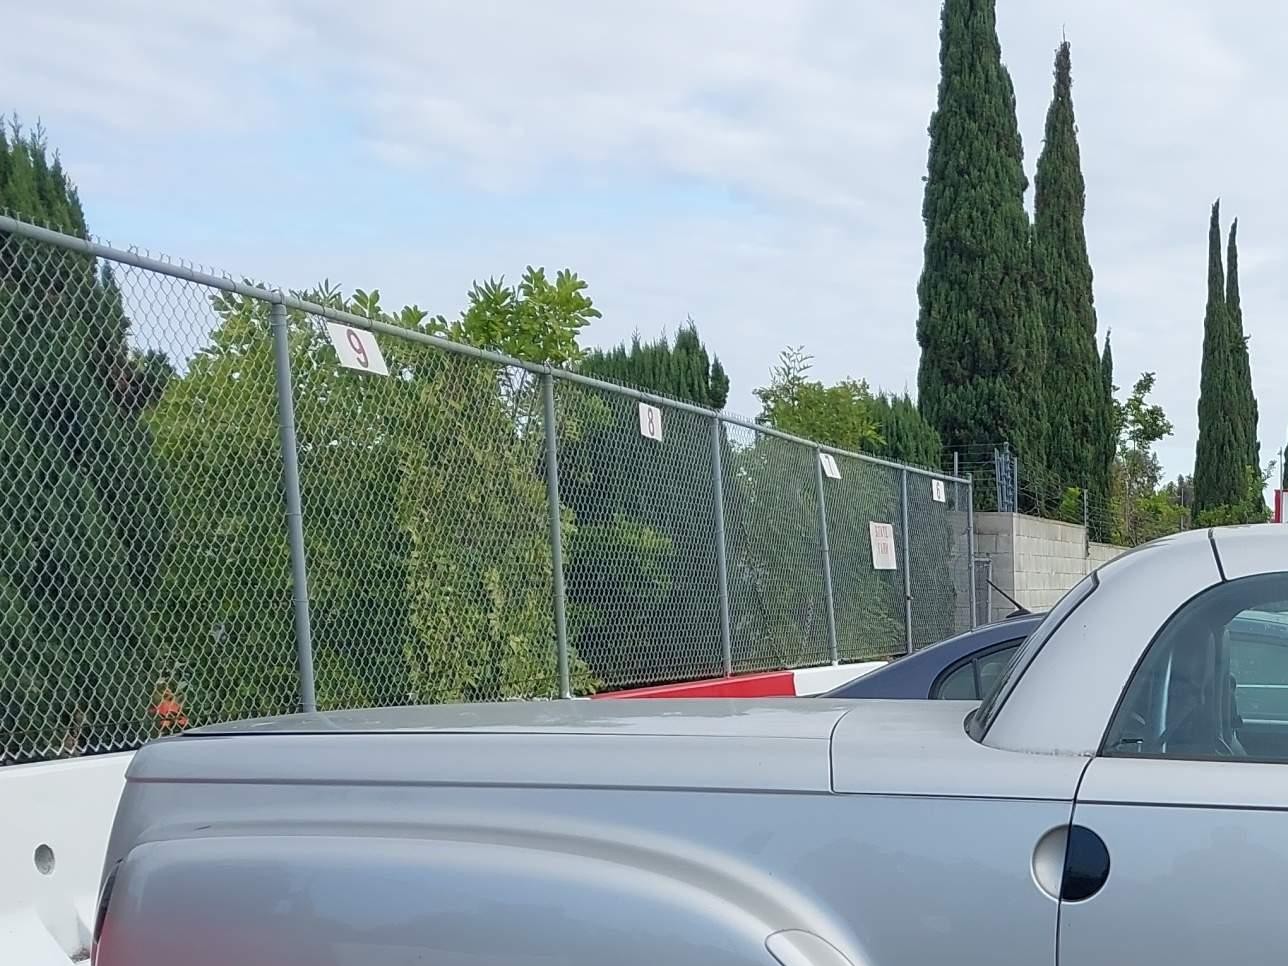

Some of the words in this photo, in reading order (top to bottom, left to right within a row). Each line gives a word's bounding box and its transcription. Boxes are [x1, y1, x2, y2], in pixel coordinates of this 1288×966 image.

[346, 328, 369, 368] 9
[647, 407, 655, 437] 8
[824, 454, 835, 476] 7
